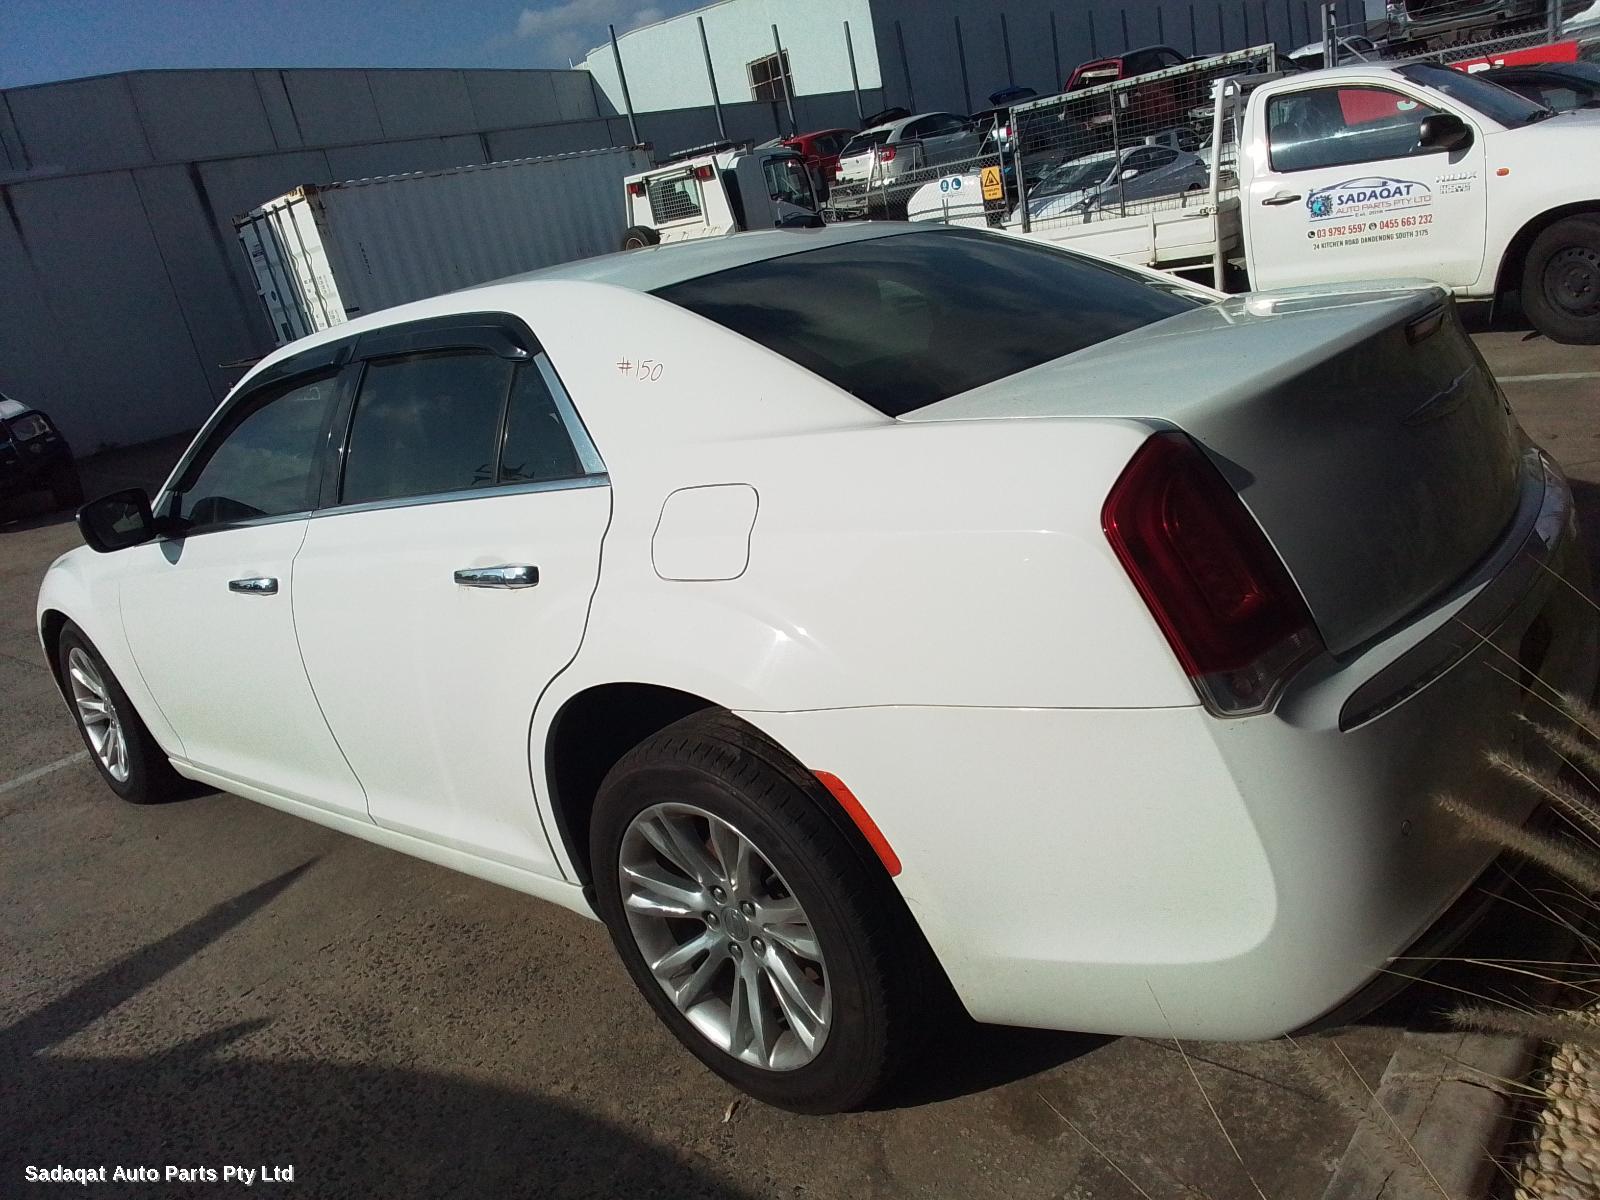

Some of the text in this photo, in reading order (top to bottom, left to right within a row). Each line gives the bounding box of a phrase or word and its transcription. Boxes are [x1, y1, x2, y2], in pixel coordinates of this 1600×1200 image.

[1336, 194, 1432, 215] AUTO PARTS PTY LTD
[1337, 184, 1413, 206] SADAQAT
[1317, 214, 1433, 239] 03 9792 5597 0455 663 232
[1321, 240, 1344, 248] KITCHEN
[1360, 234, 1395, 244] DANDENONG
[1395, 231, 1414, 240] SOUTH
[1415, 229, 1429, 237] 3175
[616, 356, 664, 381] #150
